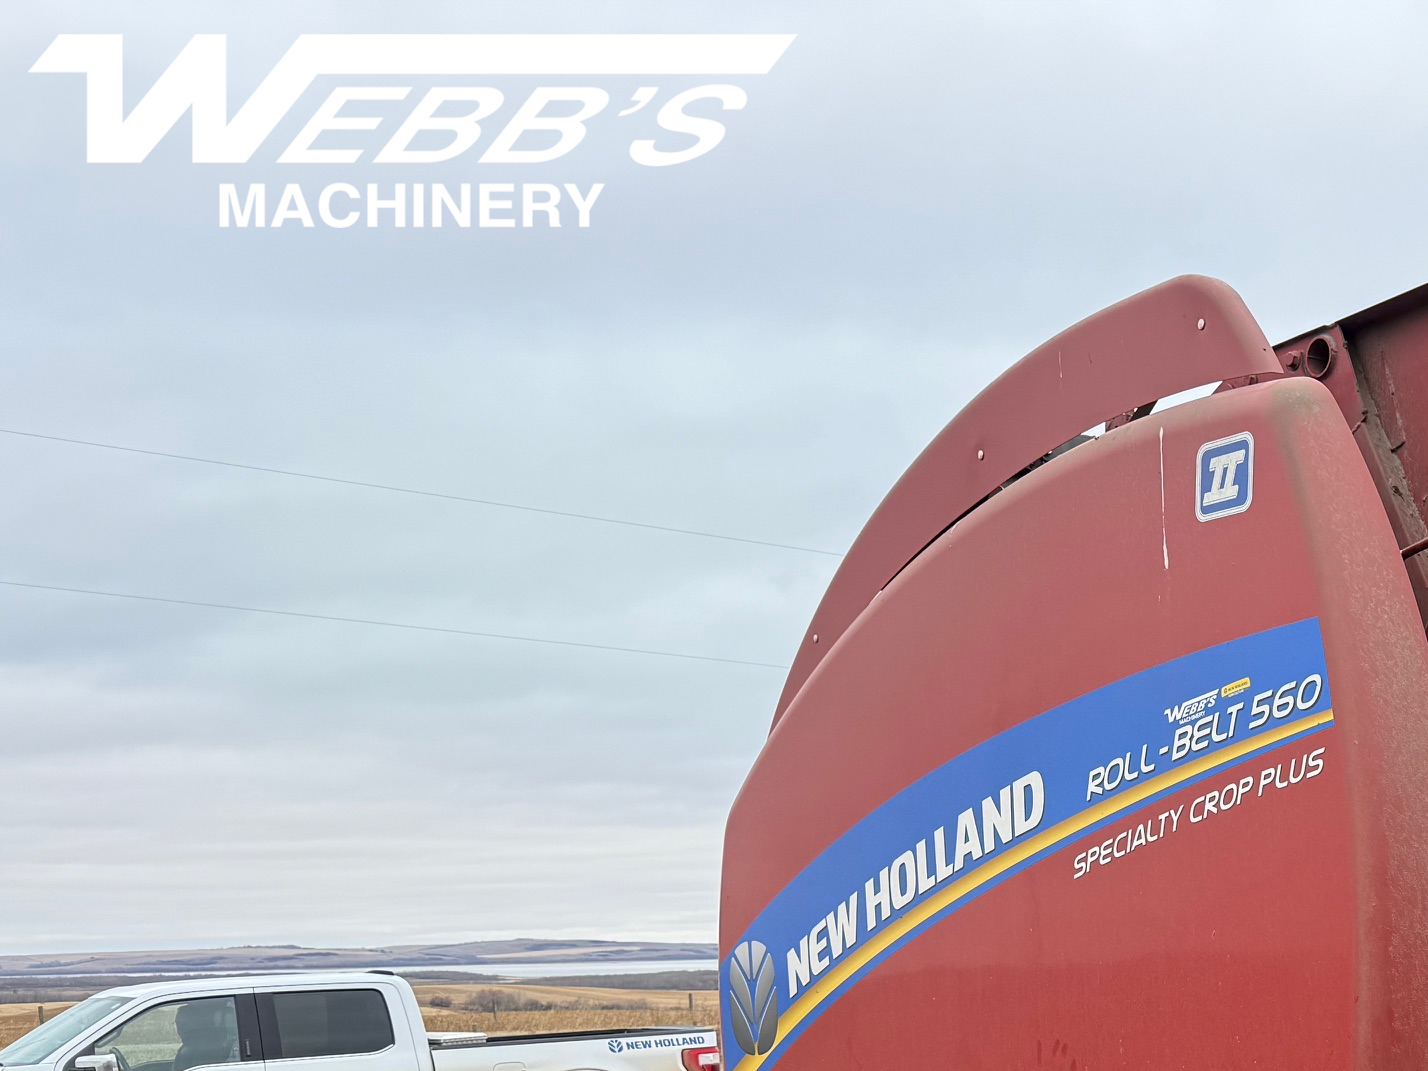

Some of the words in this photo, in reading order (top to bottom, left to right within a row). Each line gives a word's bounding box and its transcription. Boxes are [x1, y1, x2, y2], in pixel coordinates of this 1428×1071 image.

[1086, 702, 1244, 801] ROLL-BELT
[1249, 674, 1322, 730] 560
[1164, 689, 1220, 723] WEBB'S
[1073, 804, 1184, 880] SPECIALTY
[1189, 775, 1255, 823] CROP
[1257, 747, 1326, 797] PLUS
[786, 891, 858, 998] NEW
[864, 770, 1046, 933] HOLLAND
[626, 1040, 651, 1050] NEW
[655, 1036, 705, 1048] HOLLAND
